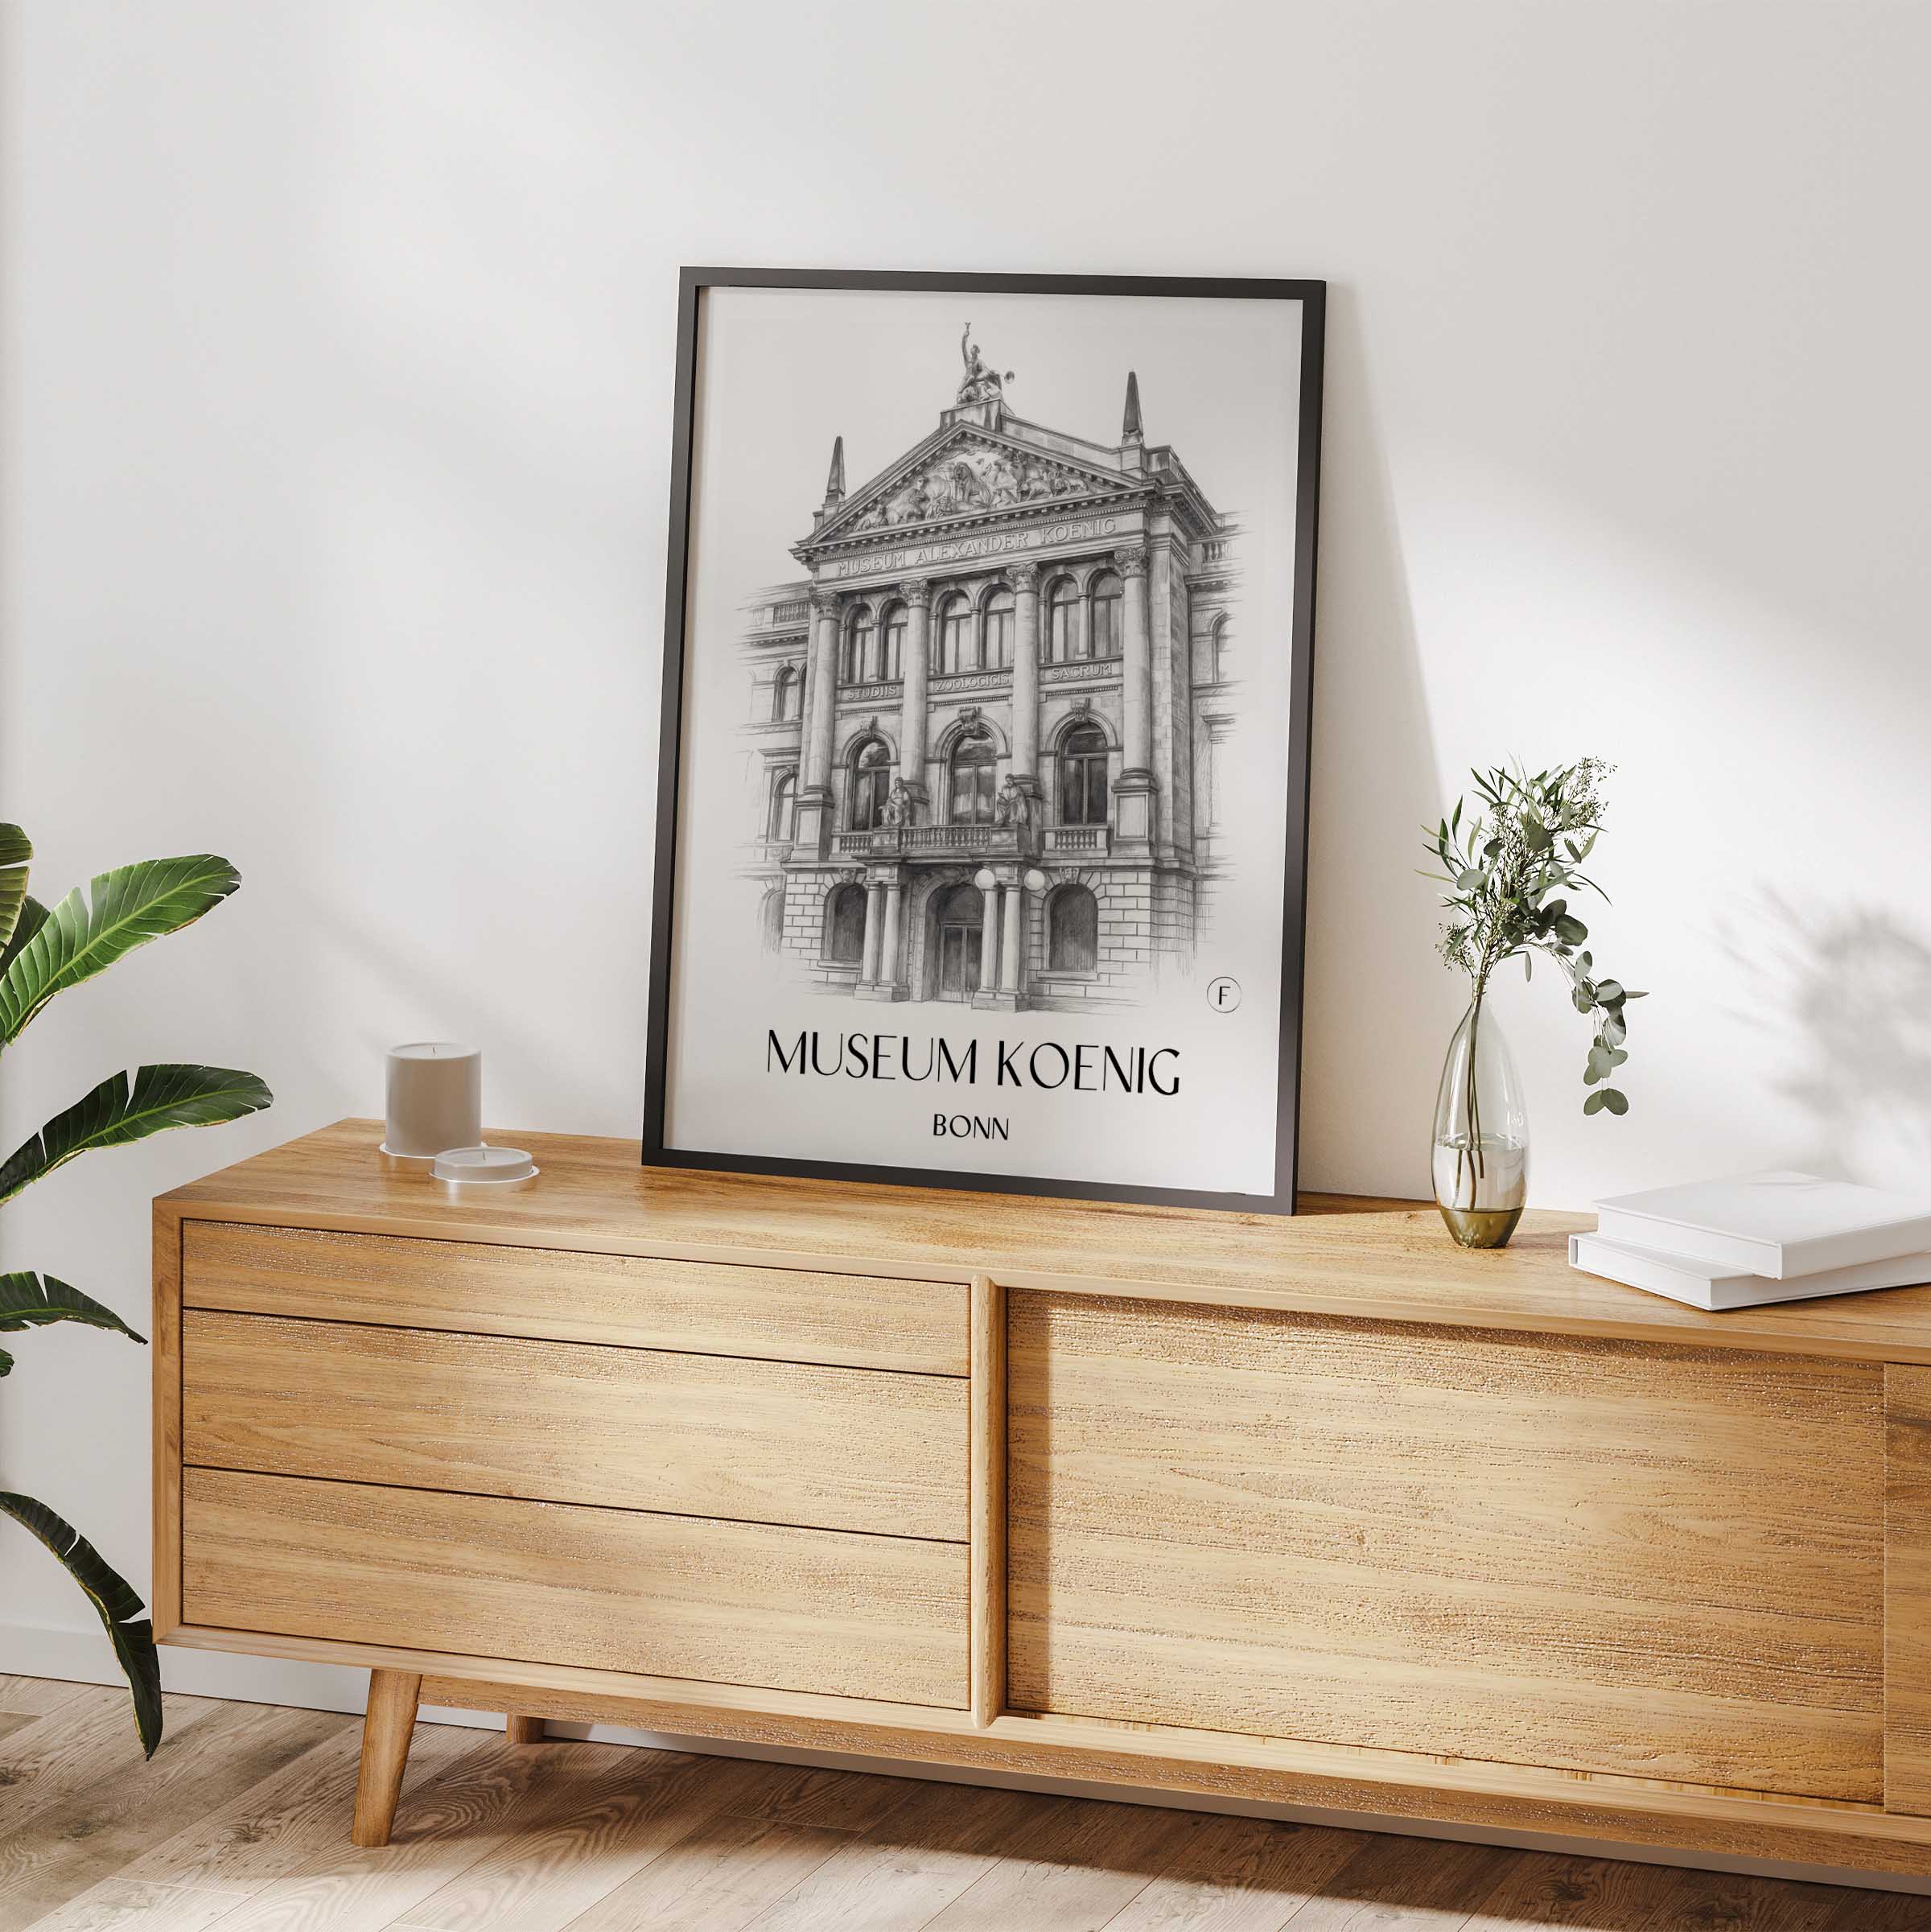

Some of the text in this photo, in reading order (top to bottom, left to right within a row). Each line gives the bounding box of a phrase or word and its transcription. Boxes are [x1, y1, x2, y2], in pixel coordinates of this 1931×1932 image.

[837, 518, 1116, 577] MUSEUM ALEXANDER KOENIG
[1051, 663, 1113, 680] SACRUM
[1219, 987, 1231, 1005] F
[767, 1029, 1180, 1096] MUSEUM KOENIG
[933, 1114, 1009, 1140] BONN
